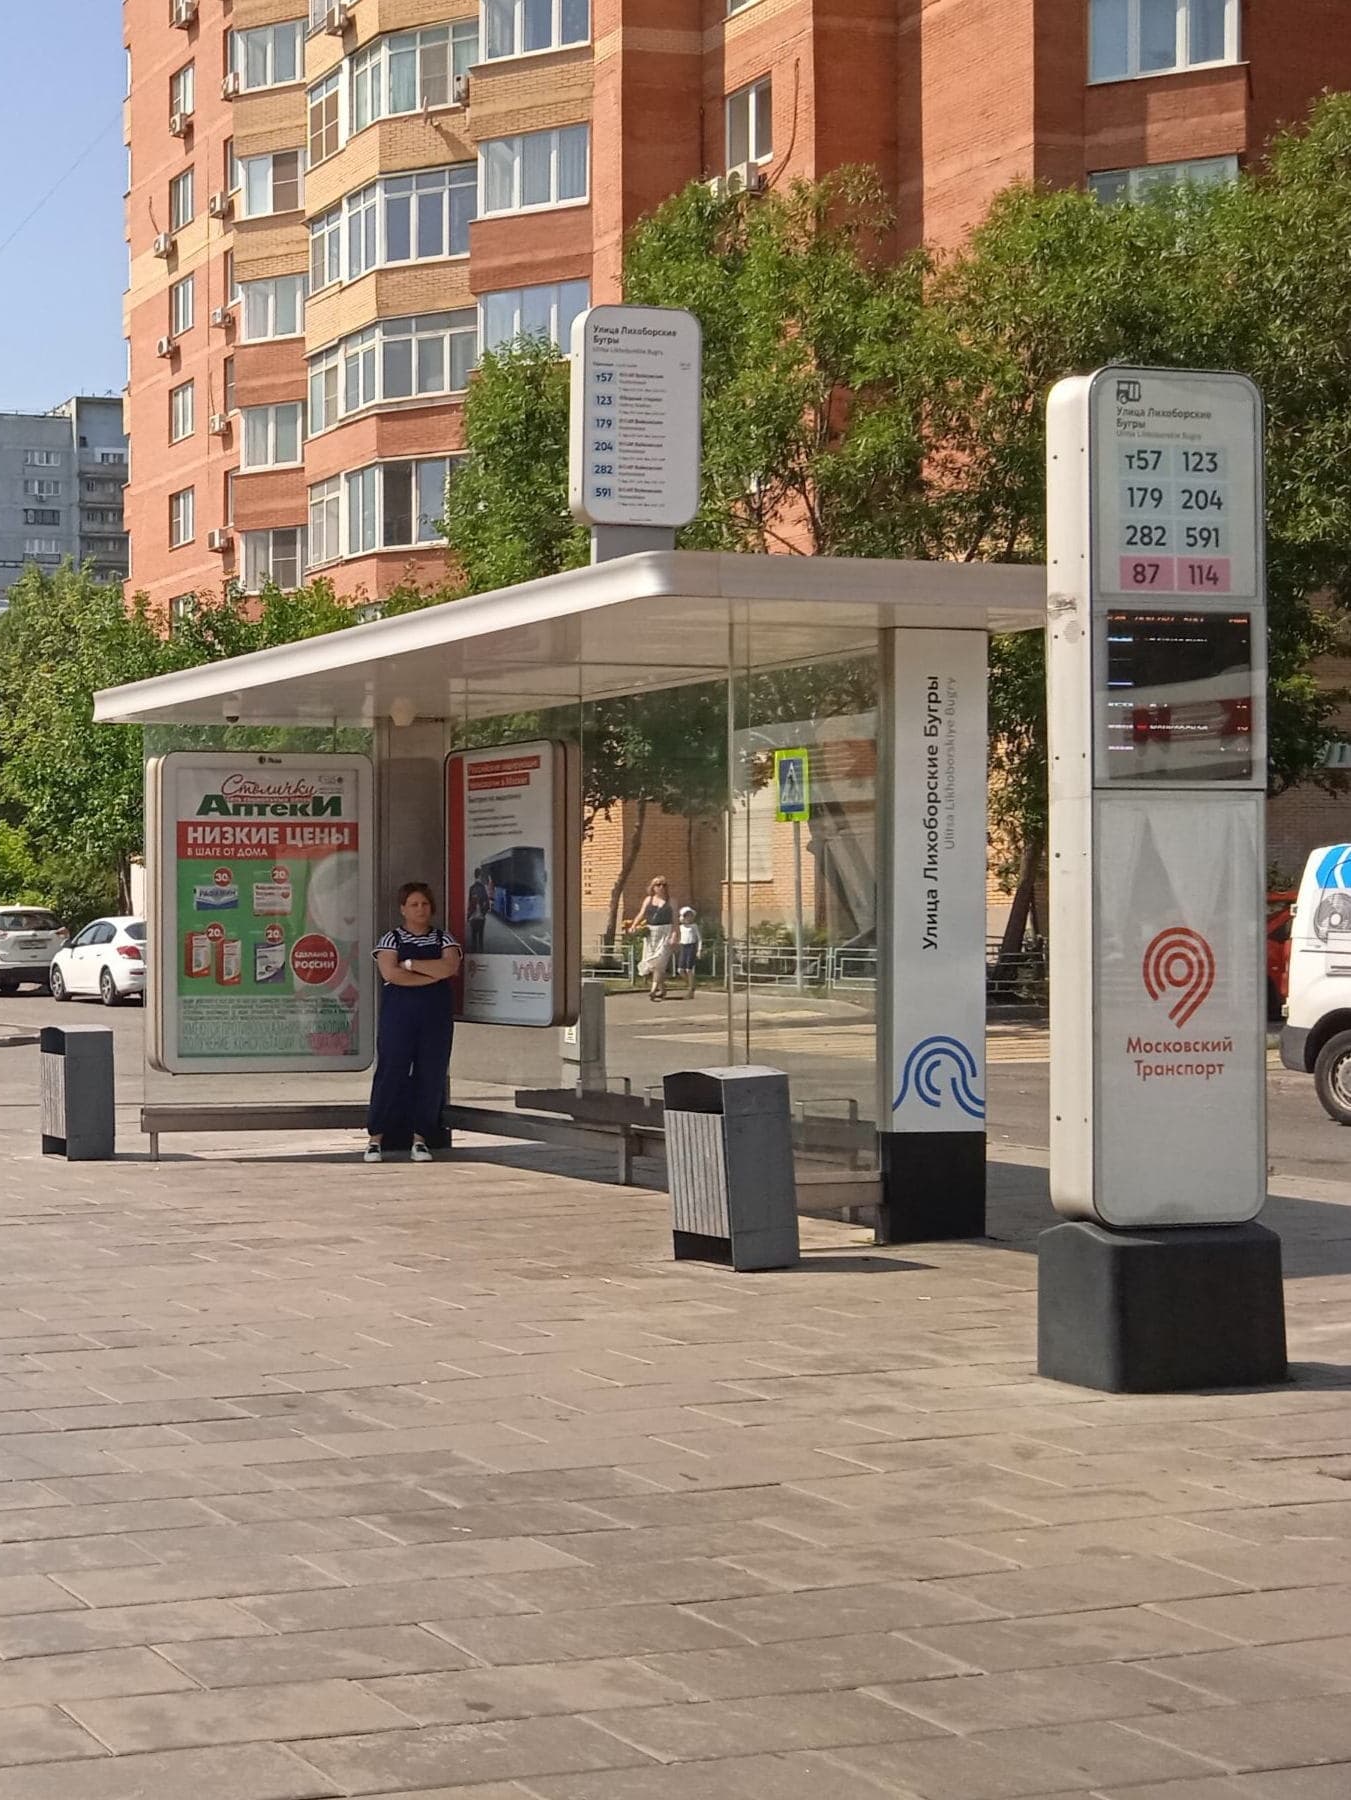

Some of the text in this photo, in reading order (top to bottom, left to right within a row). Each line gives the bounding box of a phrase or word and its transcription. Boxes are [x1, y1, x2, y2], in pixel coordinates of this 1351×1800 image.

[593, 325, 619, 336] Улица
[593, 335, 619, 346] Бугры
[596, 396, 613, 406] 123
[1116, 407, 1212, 422] Улица Лихоборские
[596, 419, 613, 429] 179
[1116, 418, 1146, 430] Бугры
[594, 442, 613, 452] 204
[1182, 452, 1219, 473] 123
[594, 465, 613, 475] 282
[595, 488, 612, 497] 591
[1127, 487, 1223, 510] 179 204
[1125, 525, 1220, 549] 282 591
[1132, 563, 1219, 586] 87 114
[922, 675, 942, 950] Улица Лихоборские Бугры
[187, 826, 349, 848] НИЗКИЕ ЦЕНЫ
[195, 848, 221, 857] ШАГЕ
[223, 848, 235, 857] ОТ
[237, 848, 268, 857] ДОМА
[1126, 1036, 1233, 1054] Московский
[1134, 1060, 1225, 1081] Транспорт
